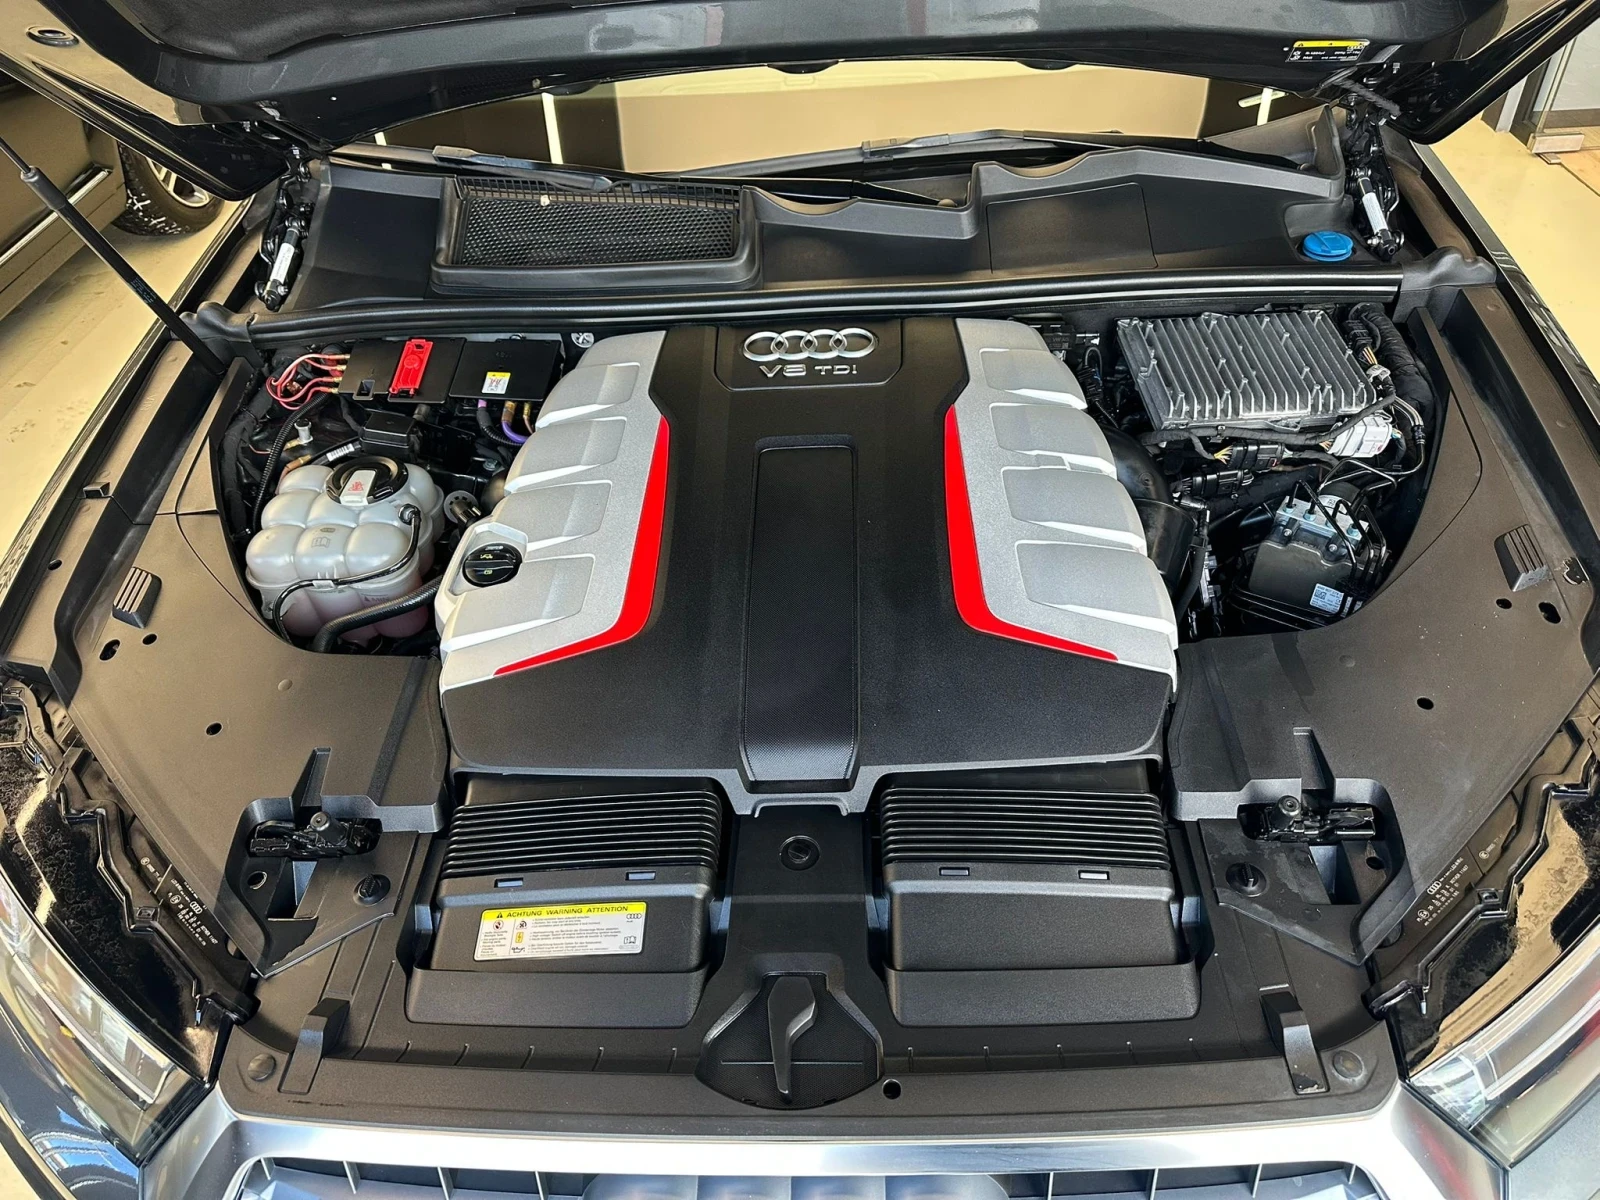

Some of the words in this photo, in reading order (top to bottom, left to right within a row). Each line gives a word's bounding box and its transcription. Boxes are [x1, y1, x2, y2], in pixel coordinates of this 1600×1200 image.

[759, 364, 807, 378] V8
[814, 364, 858, 375] TDI
[506, 910, 542, 918] ACHTUNG
[546, 907, 583, 915] WARNING
[586, 905, 629, 913] ATTENTION
